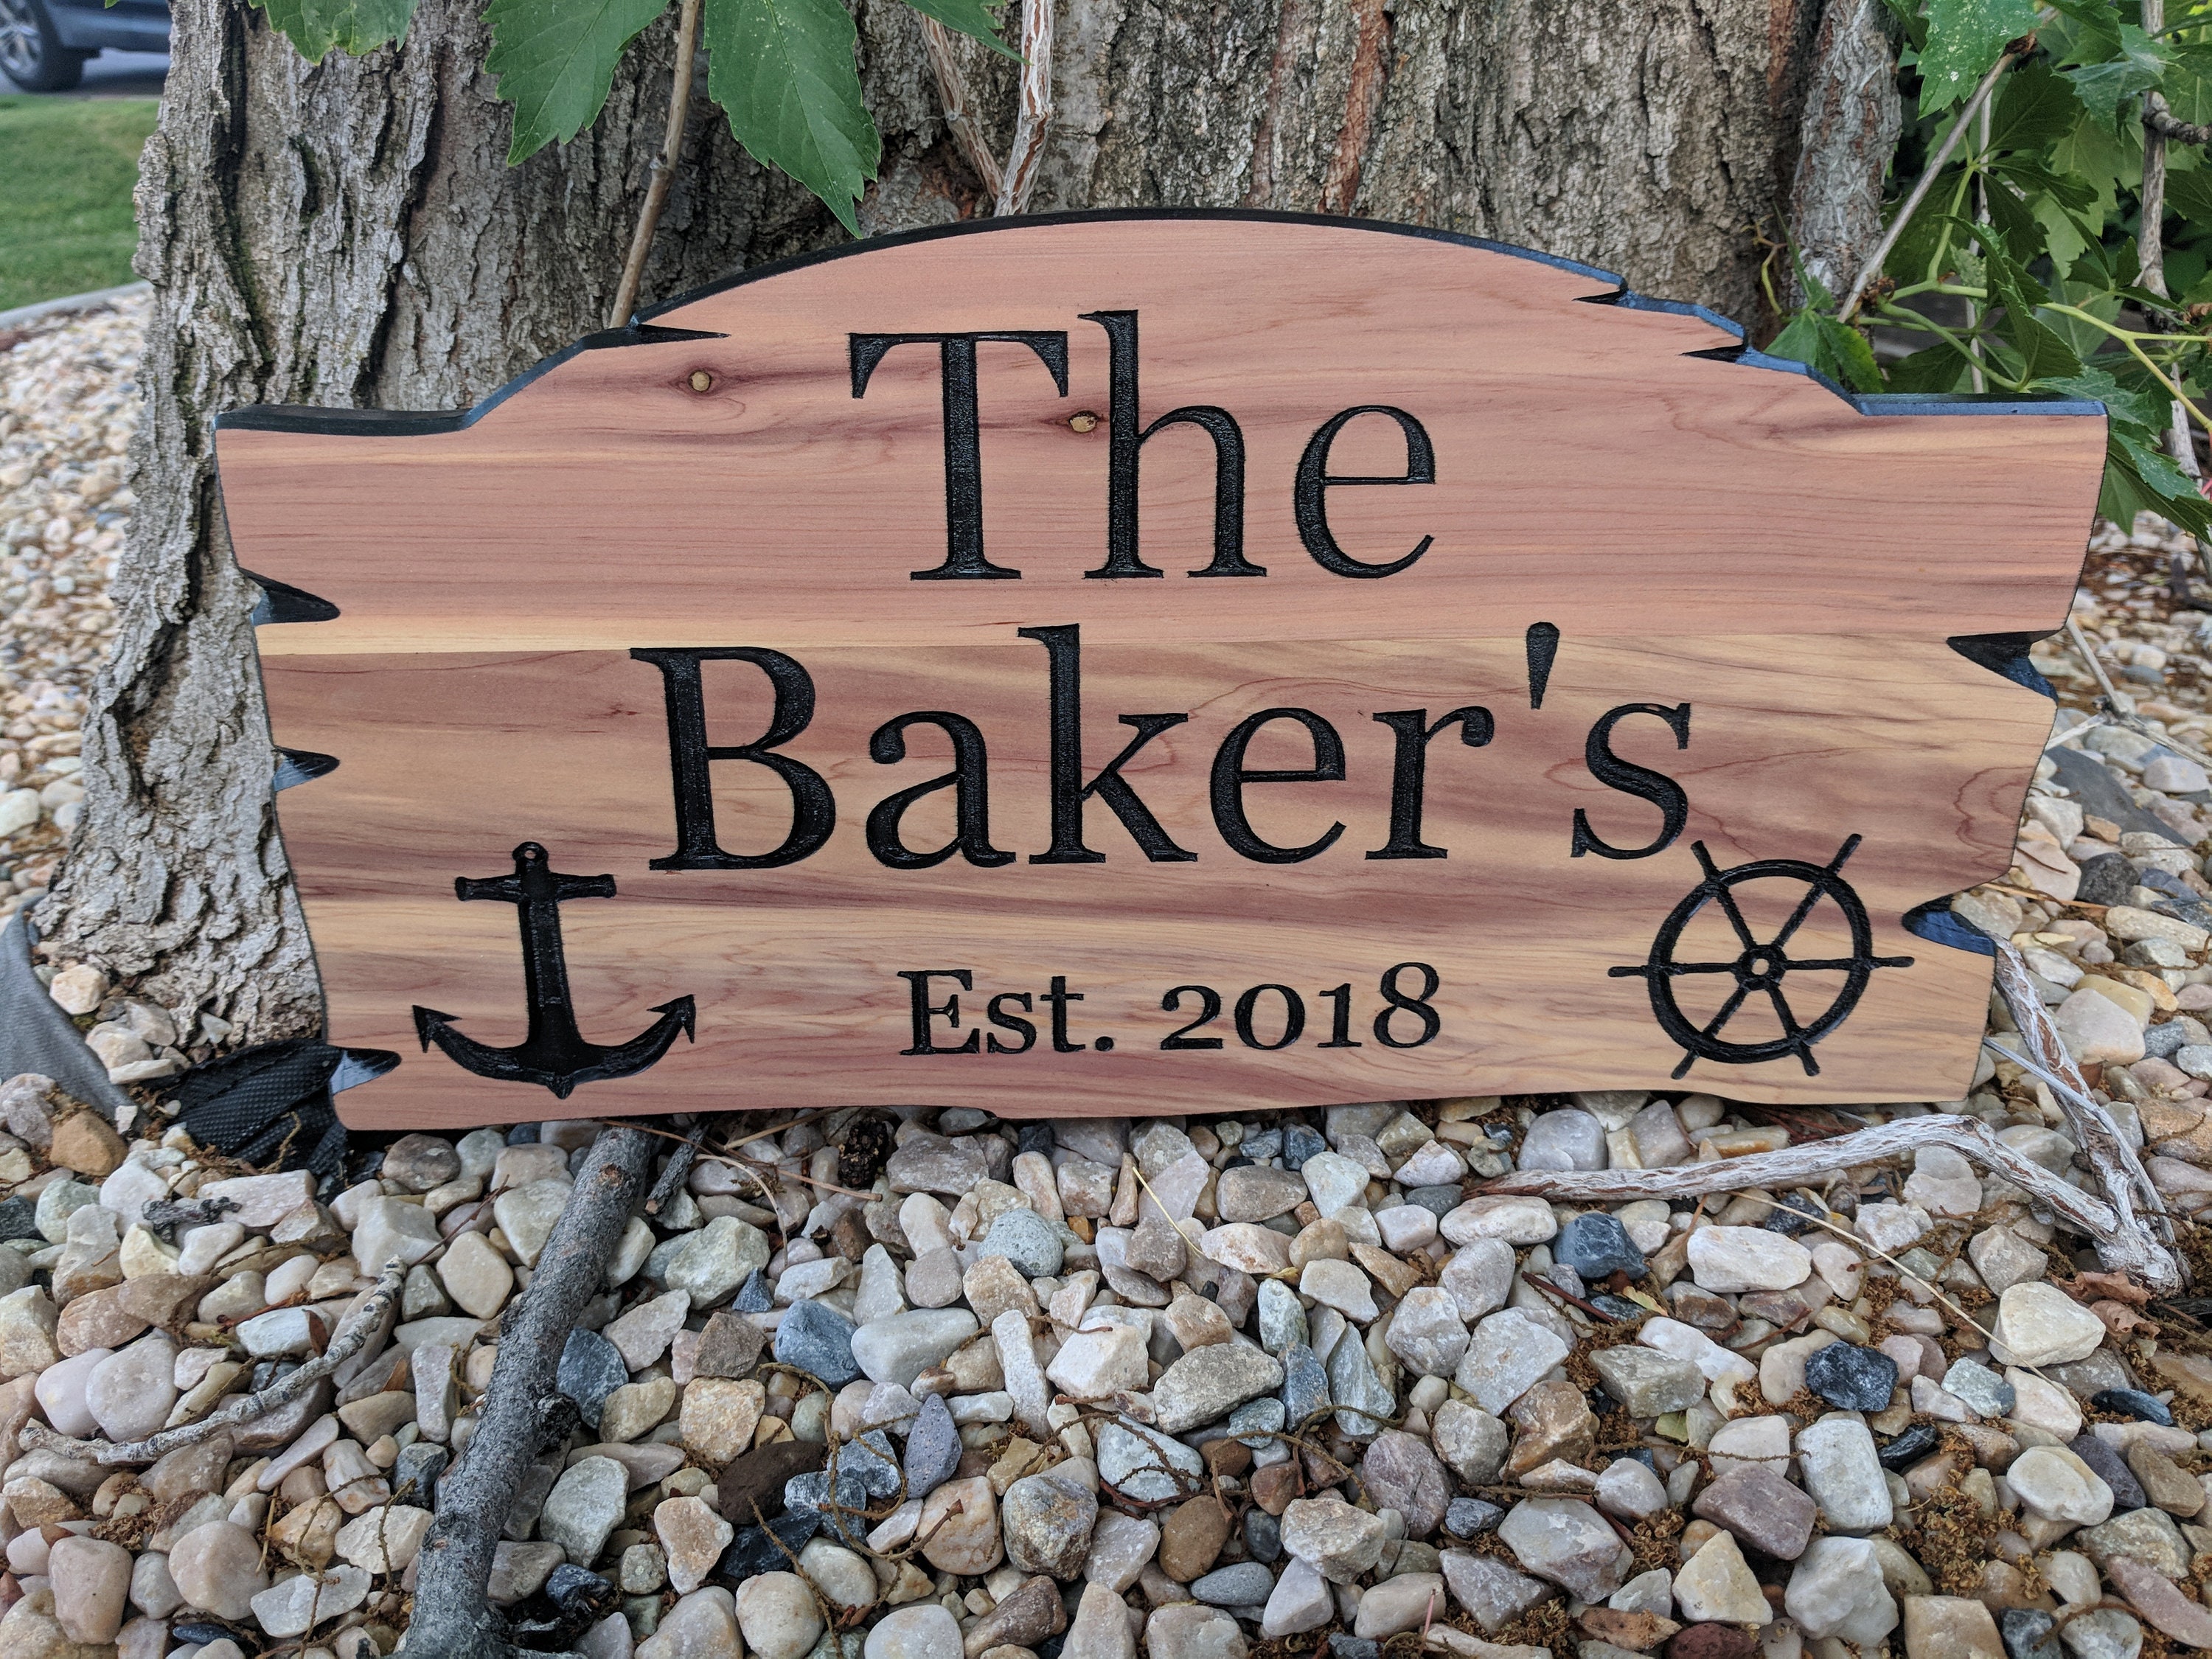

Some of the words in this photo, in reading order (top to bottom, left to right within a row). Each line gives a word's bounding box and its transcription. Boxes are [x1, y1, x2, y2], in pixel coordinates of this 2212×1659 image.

[849, 310, 1436, 580] The
[630, 622, 1692, 870] Baker's
[898, 969, 1114, 1056] Est.
[1160, 961, 1441, 1051] 2018
